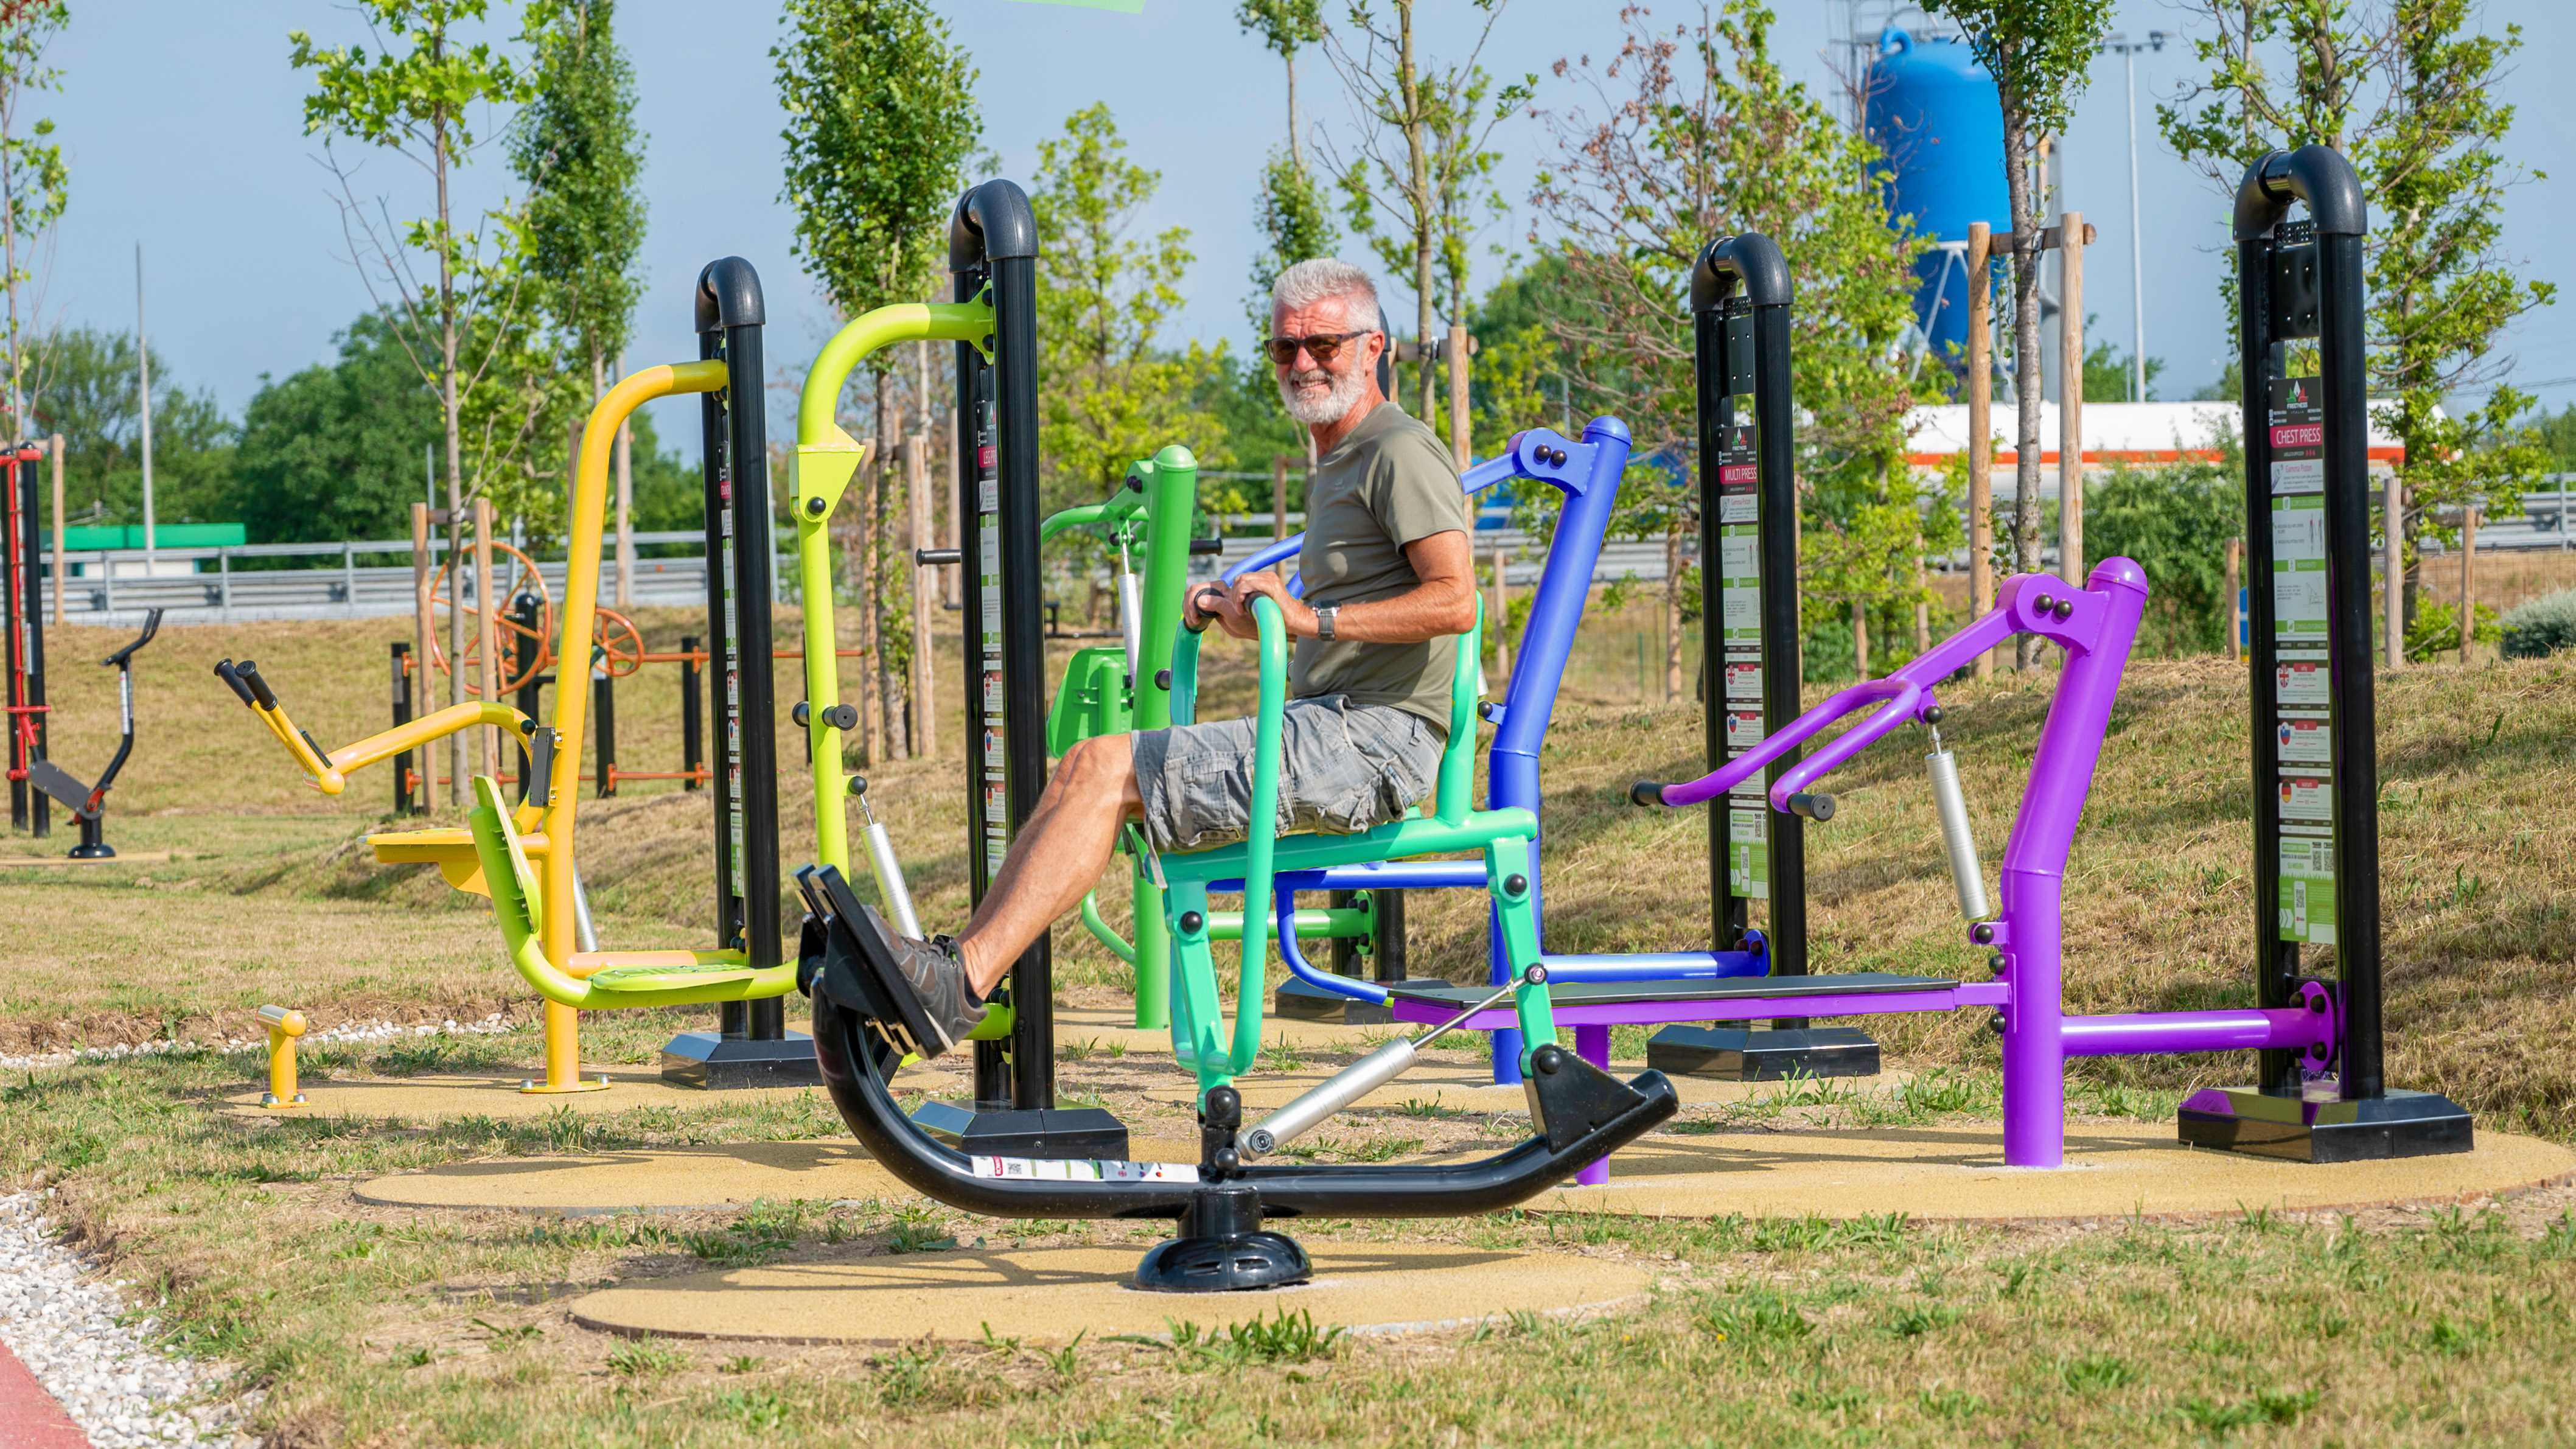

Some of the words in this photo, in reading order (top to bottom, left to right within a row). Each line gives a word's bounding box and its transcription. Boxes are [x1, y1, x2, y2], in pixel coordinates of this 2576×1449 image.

[2277, 429, 2299, 444] CHEST
[2300, 427, 2321, 442] PRESS
[1725, 468, 1740, 481] MULTI
[1741, 467, 1757, 480] PRESS
